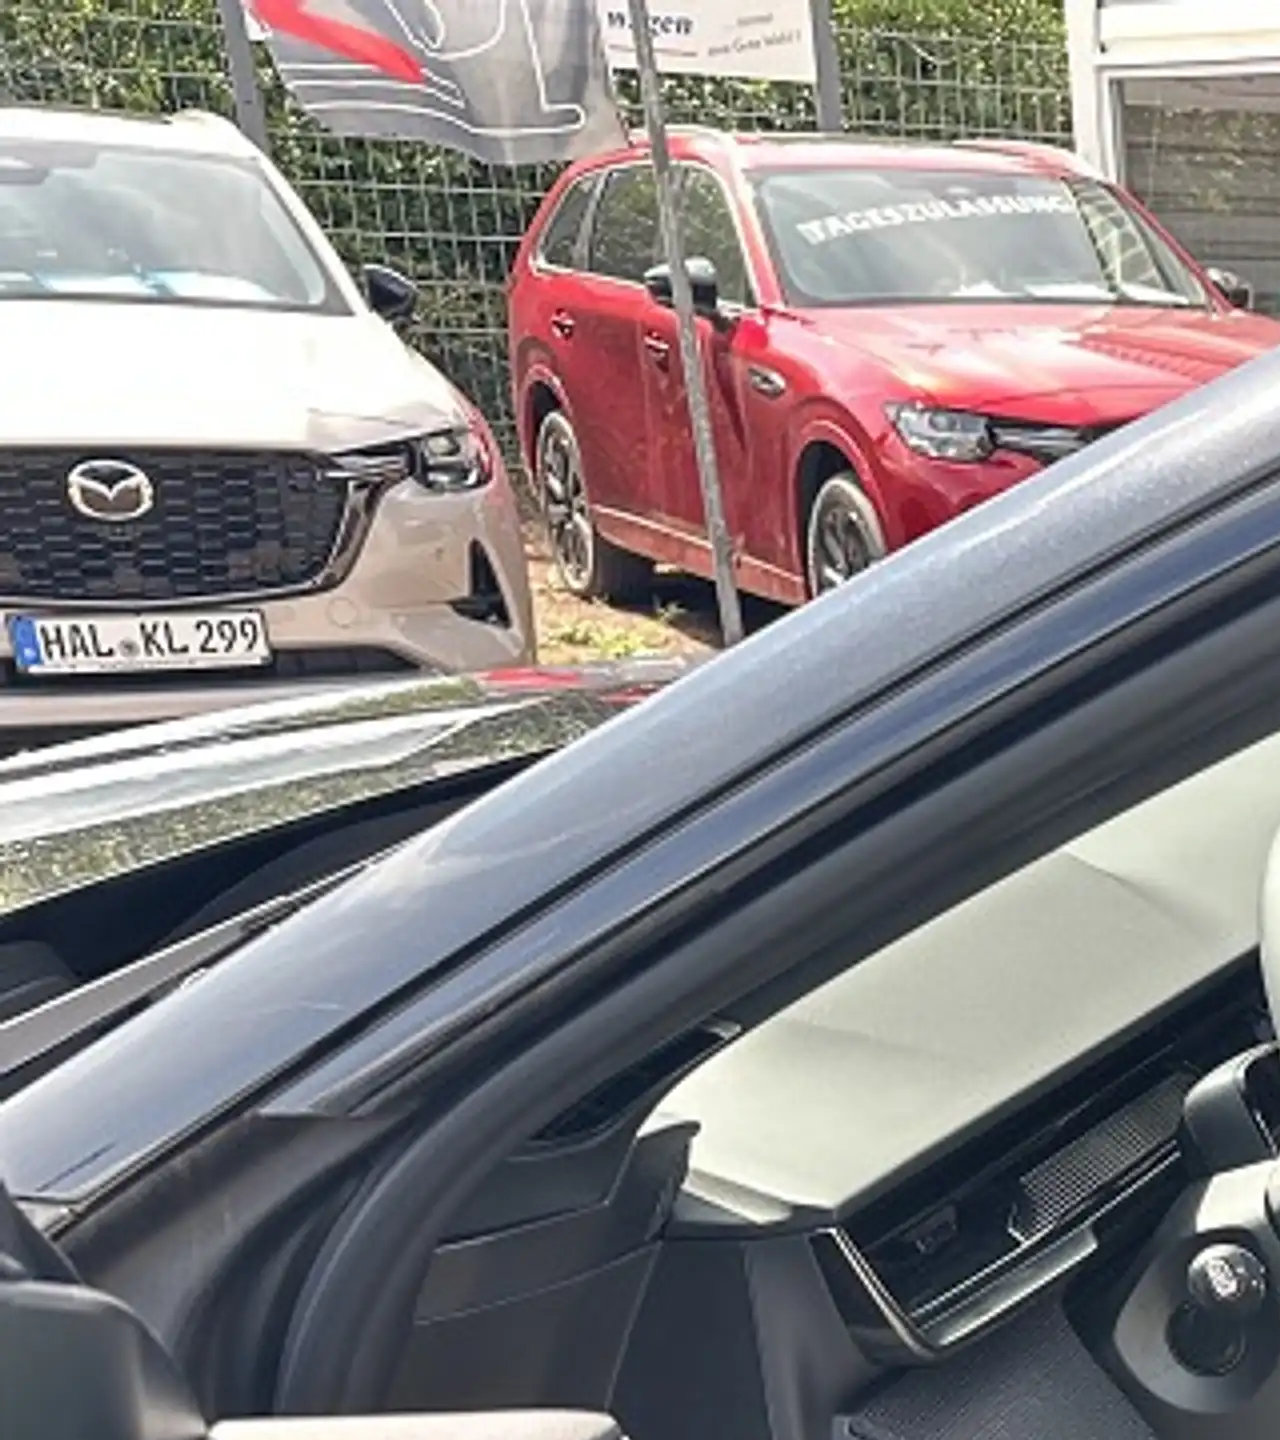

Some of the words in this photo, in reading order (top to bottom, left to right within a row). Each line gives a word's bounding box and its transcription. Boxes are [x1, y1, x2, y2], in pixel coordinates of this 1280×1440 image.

[40, 624, 113, 658] HAL
[139, 621, 189, 656] KL
[195, 617, 258, 652] 299
